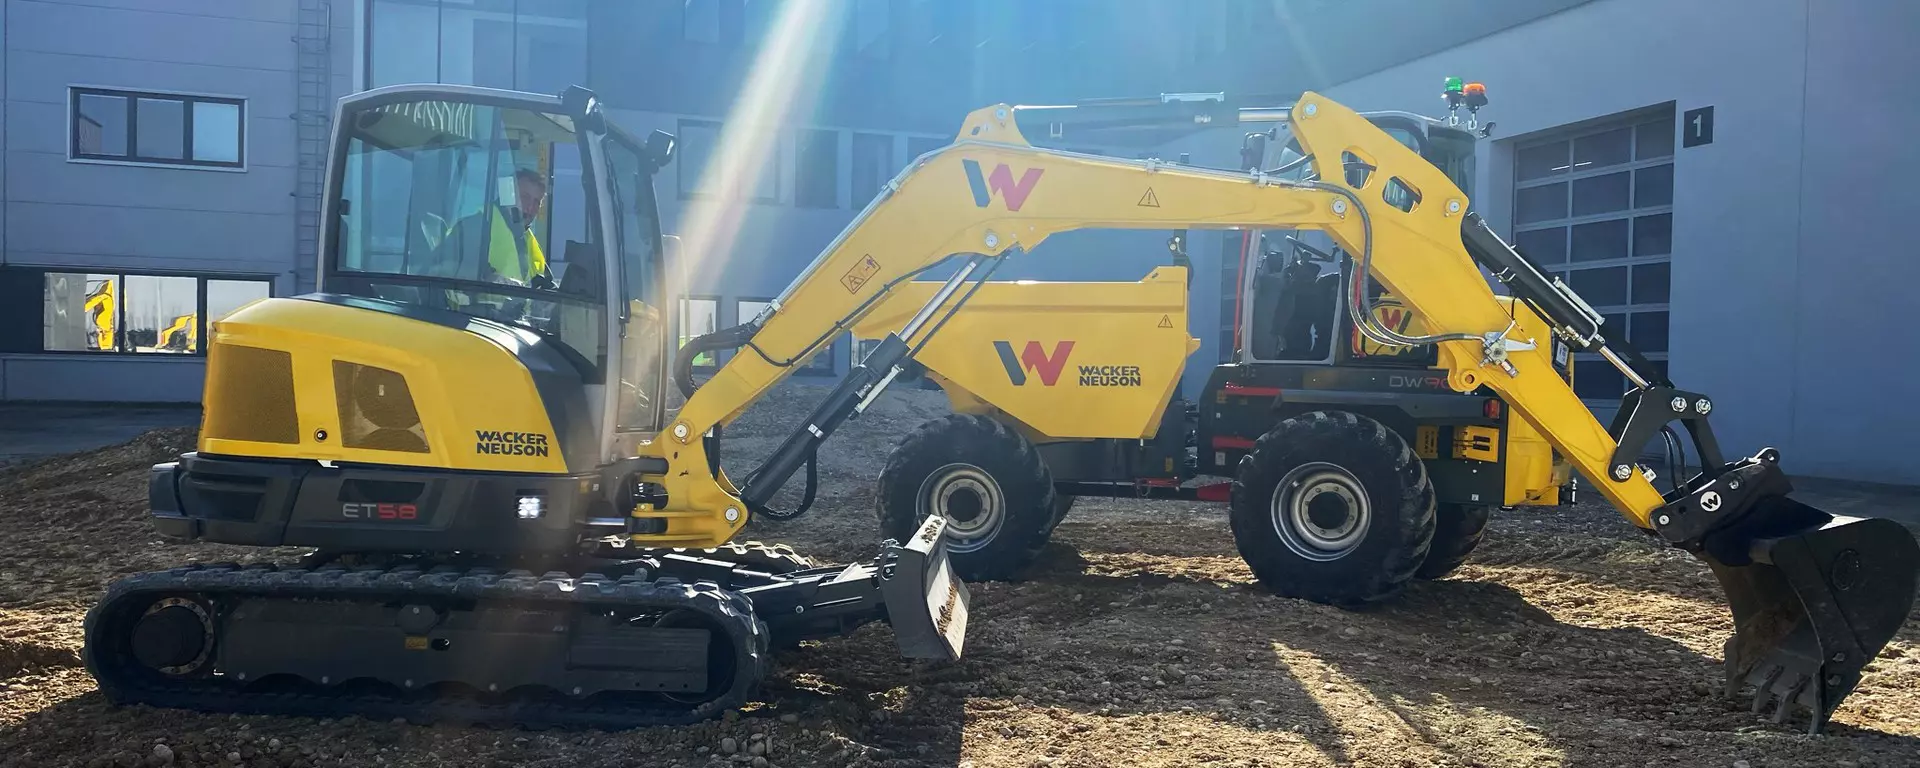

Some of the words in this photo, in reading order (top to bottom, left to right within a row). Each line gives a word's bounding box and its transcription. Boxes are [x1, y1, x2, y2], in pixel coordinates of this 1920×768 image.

[1693, 114, 1702, 137] 1
[962, 159, 1045, 211] W
[992, 341, 1076, 386] W
[1078, 365, 1141, 376] WACKER
[1079, 376, 1141, 387] NEUSON
[475, 430, 548, 445] WACKER
[477, 442, 548, 457] NEUSON
[342, 503, 417, 519] ET58
